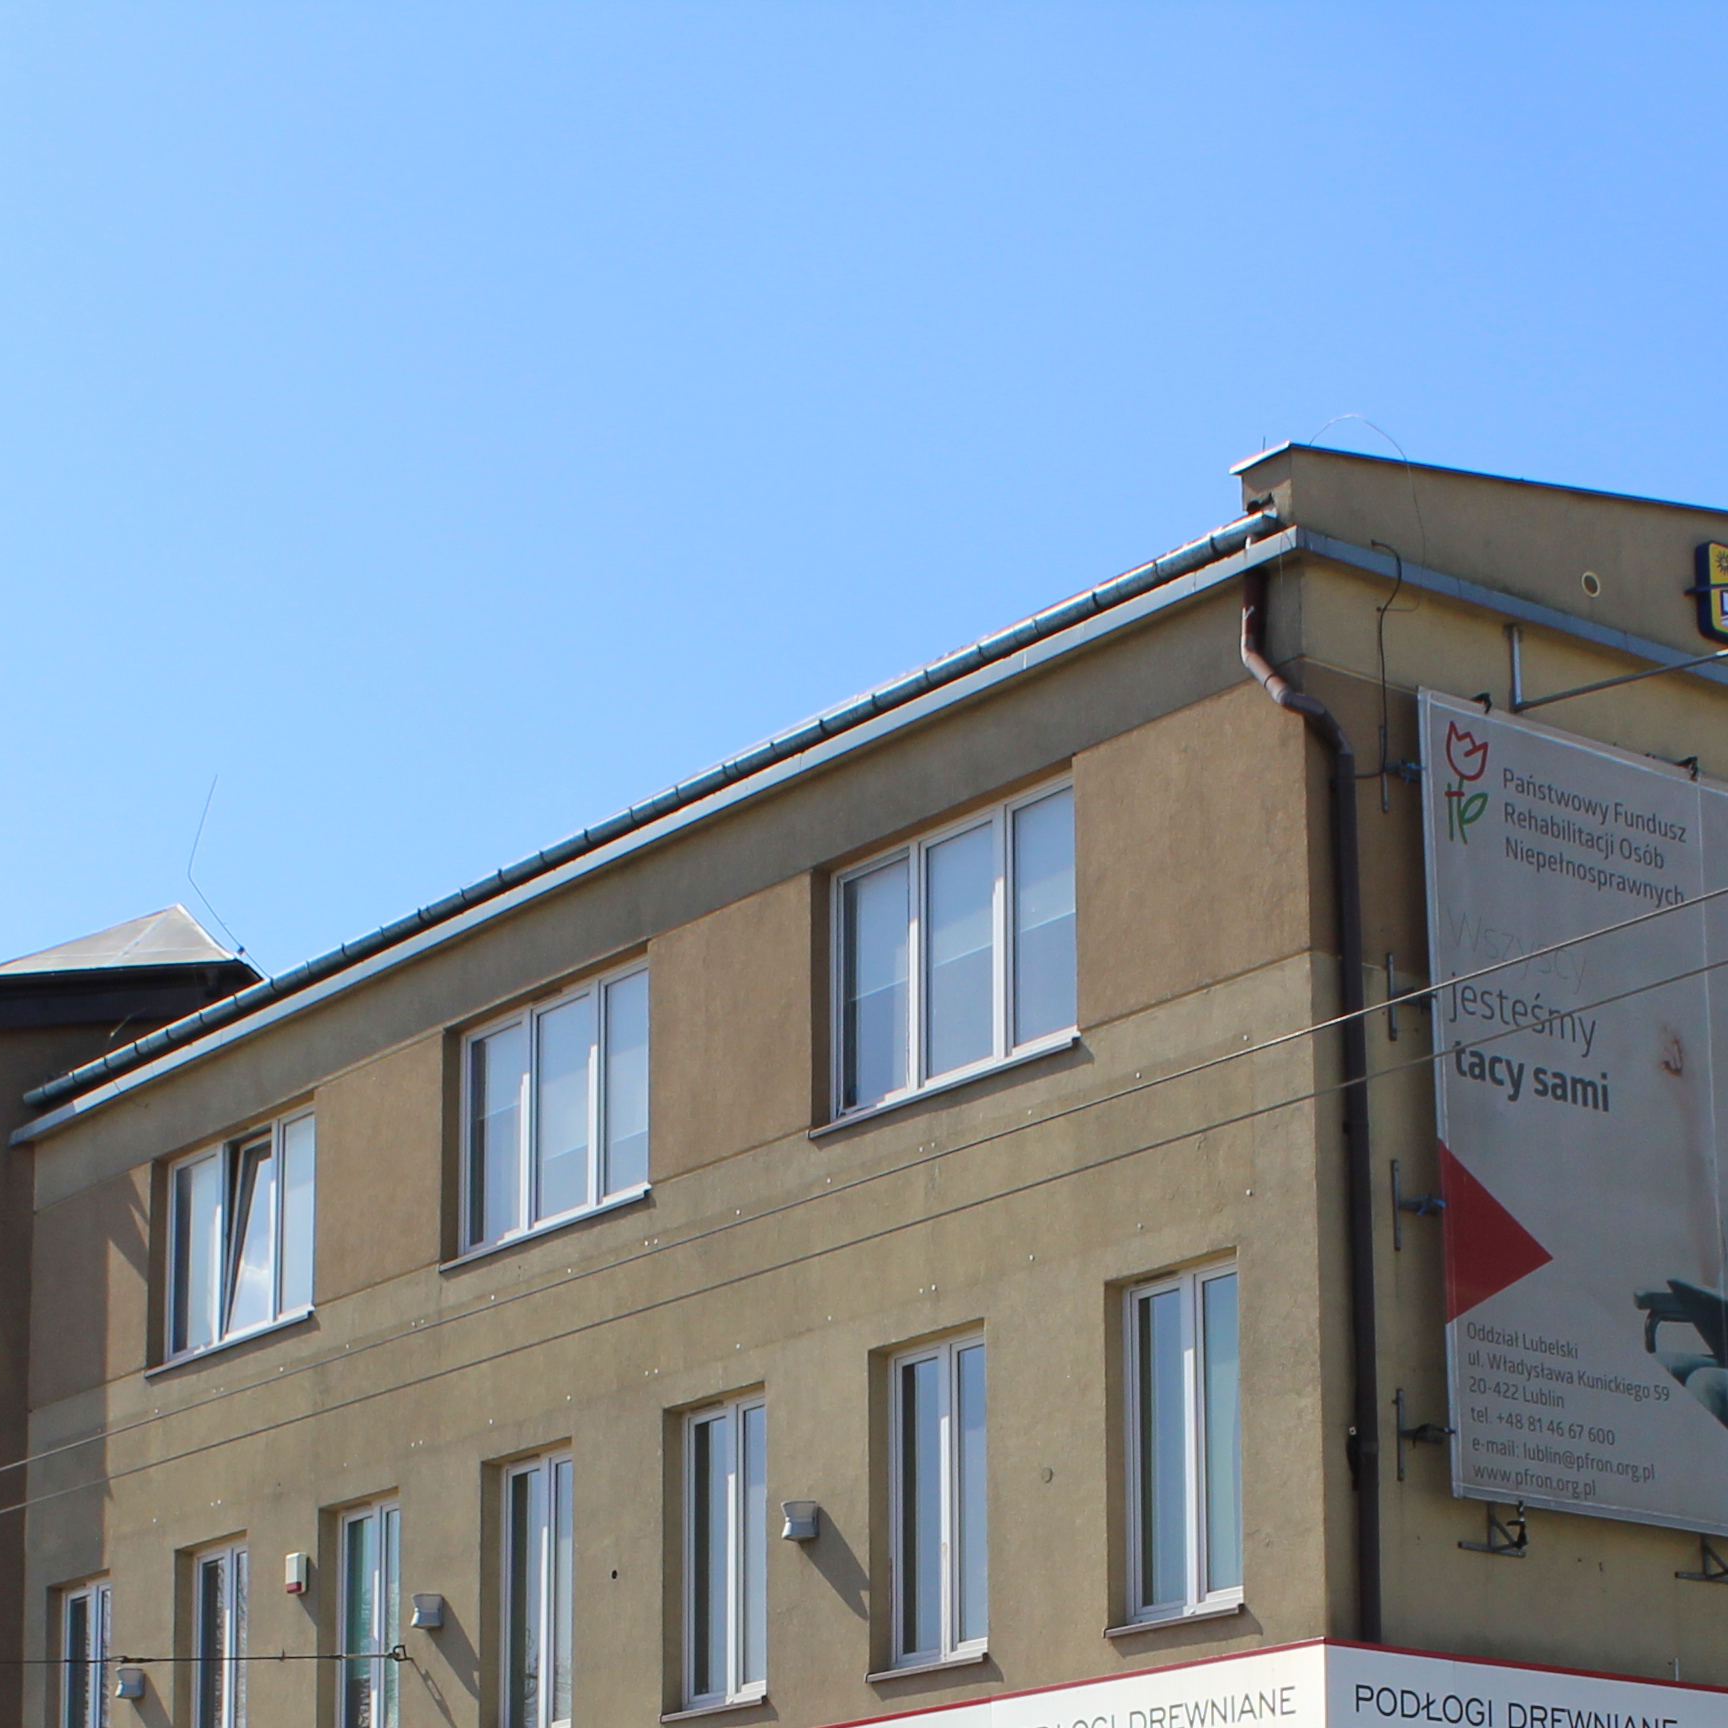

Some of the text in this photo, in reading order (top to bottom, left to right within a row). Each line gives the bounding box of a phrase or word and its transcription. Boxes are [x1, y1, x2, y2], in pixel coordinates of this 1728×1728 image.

[1503, 768, 1687, 844] Państwowy Fundusz
[1503, 803, 1665, 870] Rehabilitacji Osób
[1505, 837, 1685, 907] Niepełnosprawnych
[1446, 907, 1589, 995] Wszyscy
[1449, 972, 1597, 1058] jesteśmy
[1453, 1042, 1610, 1113] tacy sami
[1466, 1321, 1578, 1361] Oddział Lubelski
[1468, 1350, 1670, 1402] ul. Władysława Kunickiego 59
[1468, 1375, 1564, 1409] 20-422 Lublin
[1471, 1405, 1616, 1446] tel. +48 81 46 67 600
[1472, 1435, 1656, 1483] e-mail: lublin@pfron.org.pl
[1472, 1462, 1597, 1498] www.pfron.org.pl
[1356, 1684, 1493, 1728] PODŁOGI
